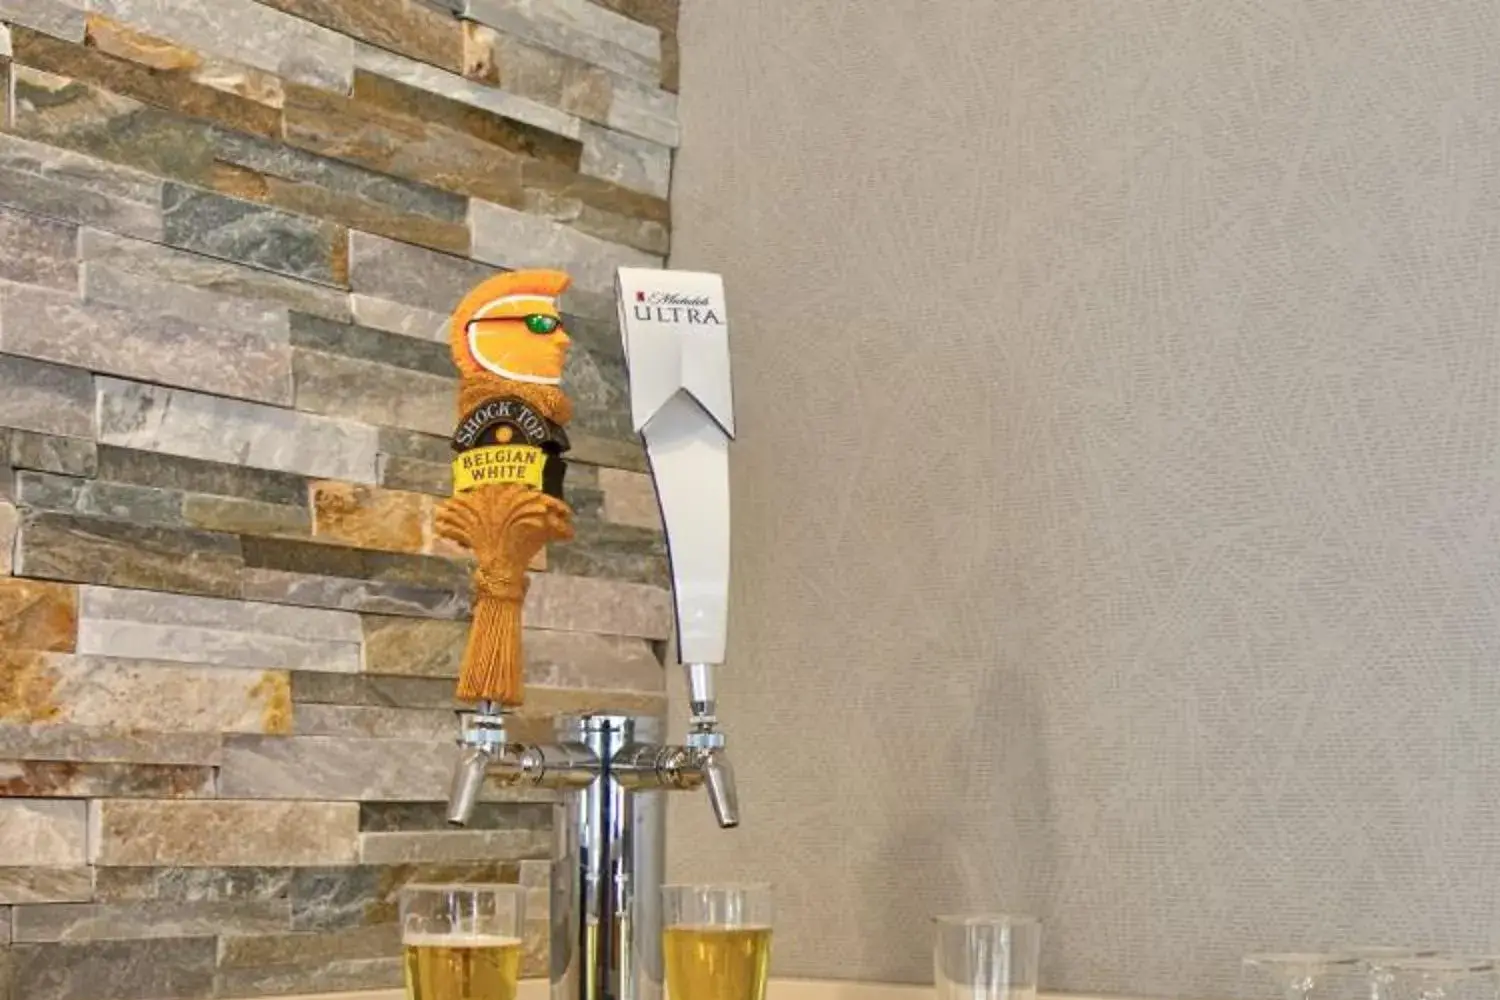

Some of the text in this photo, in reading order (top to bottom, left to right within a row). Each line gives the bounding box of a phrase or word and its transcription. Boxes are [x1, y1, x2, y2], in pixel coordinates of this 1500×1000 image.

[633, 305, 725, 325] ULTRA
[456, 401, 545, 447] SHOCK TOP
[463, 449, 537, 469] BELGIAN
[471, 465, 527, 481] WHITE
